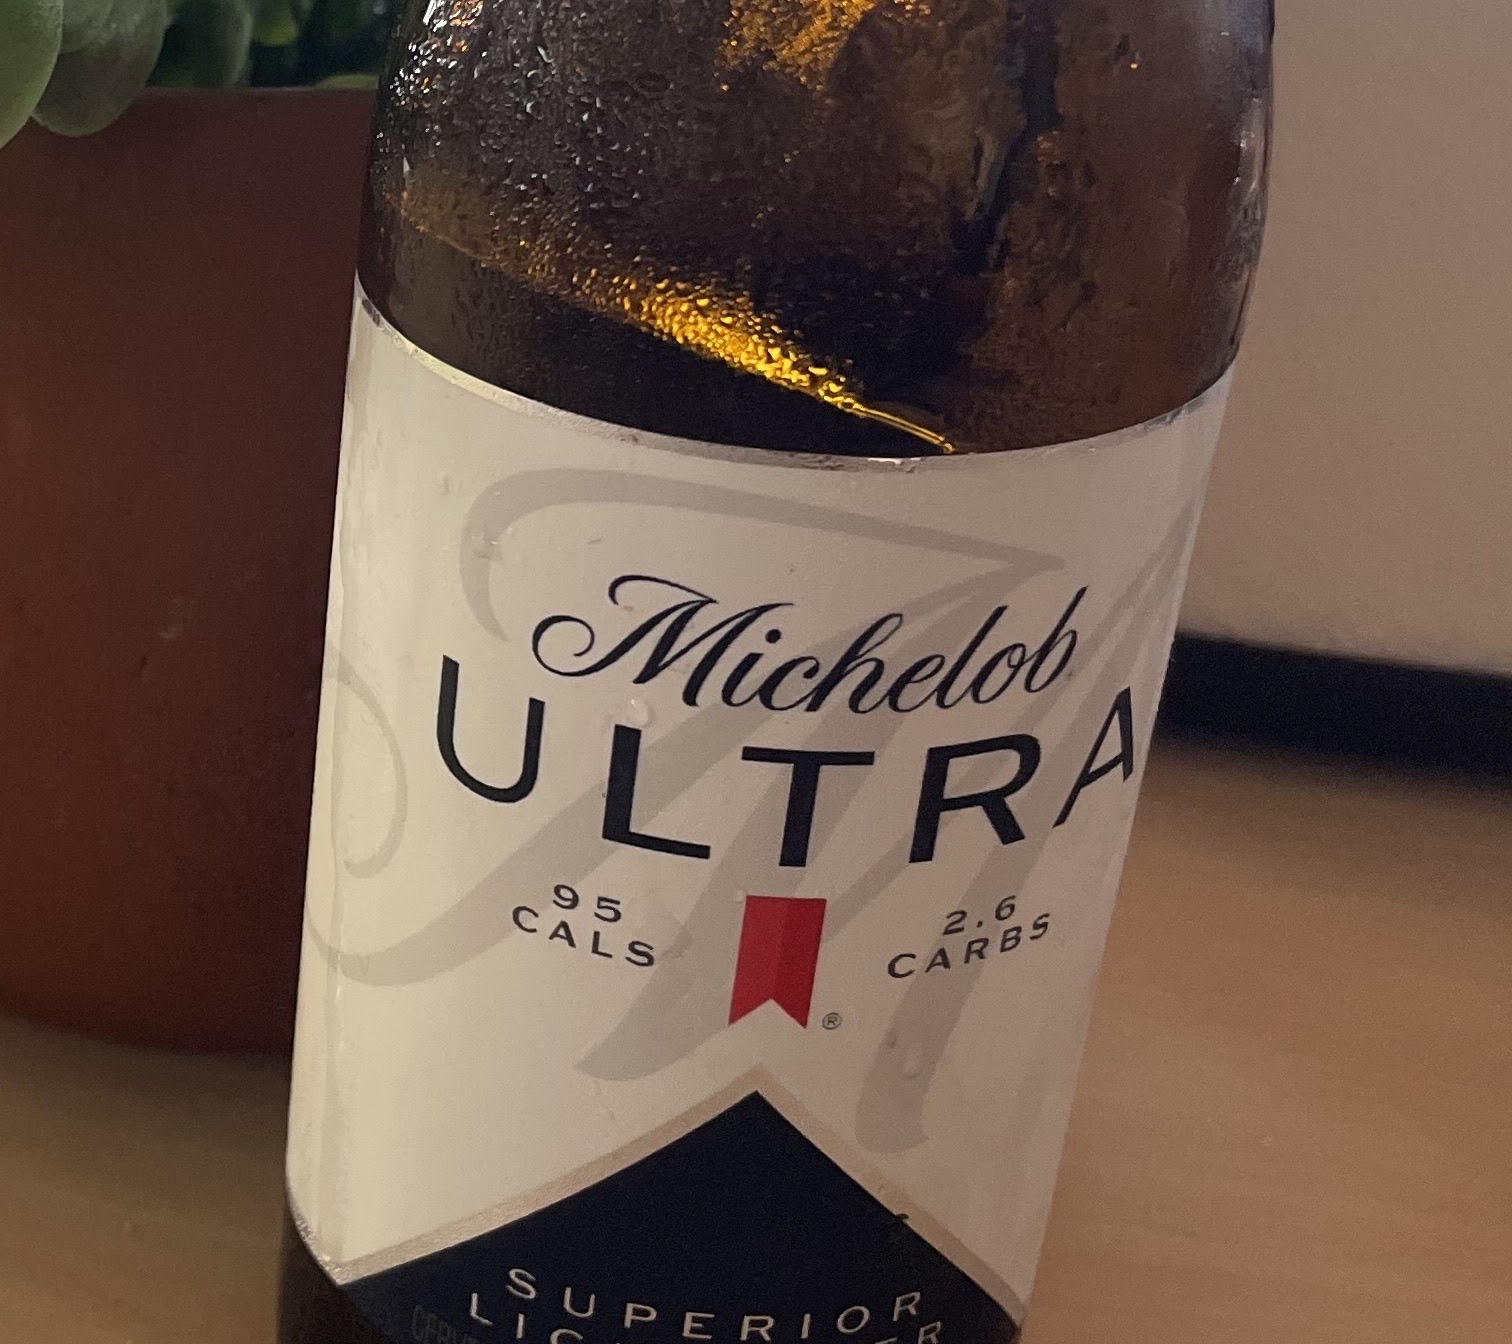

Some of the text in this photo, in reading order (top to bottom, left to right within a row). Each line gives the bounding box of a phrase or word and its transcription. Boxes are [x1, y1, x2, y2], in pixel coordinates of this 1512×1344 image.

[531, 573, 1088, 715] Michelob
[435, 654, 1136, 868] ULTRA
[511, 904, 656, 969] CALS
[551, 884, 623, 924] 95
[940, 895, 1018, 938] 2.6
[887, 911, 1052, 980] CARBS
[506, 1267, 922, 1342] SUPERIOR
